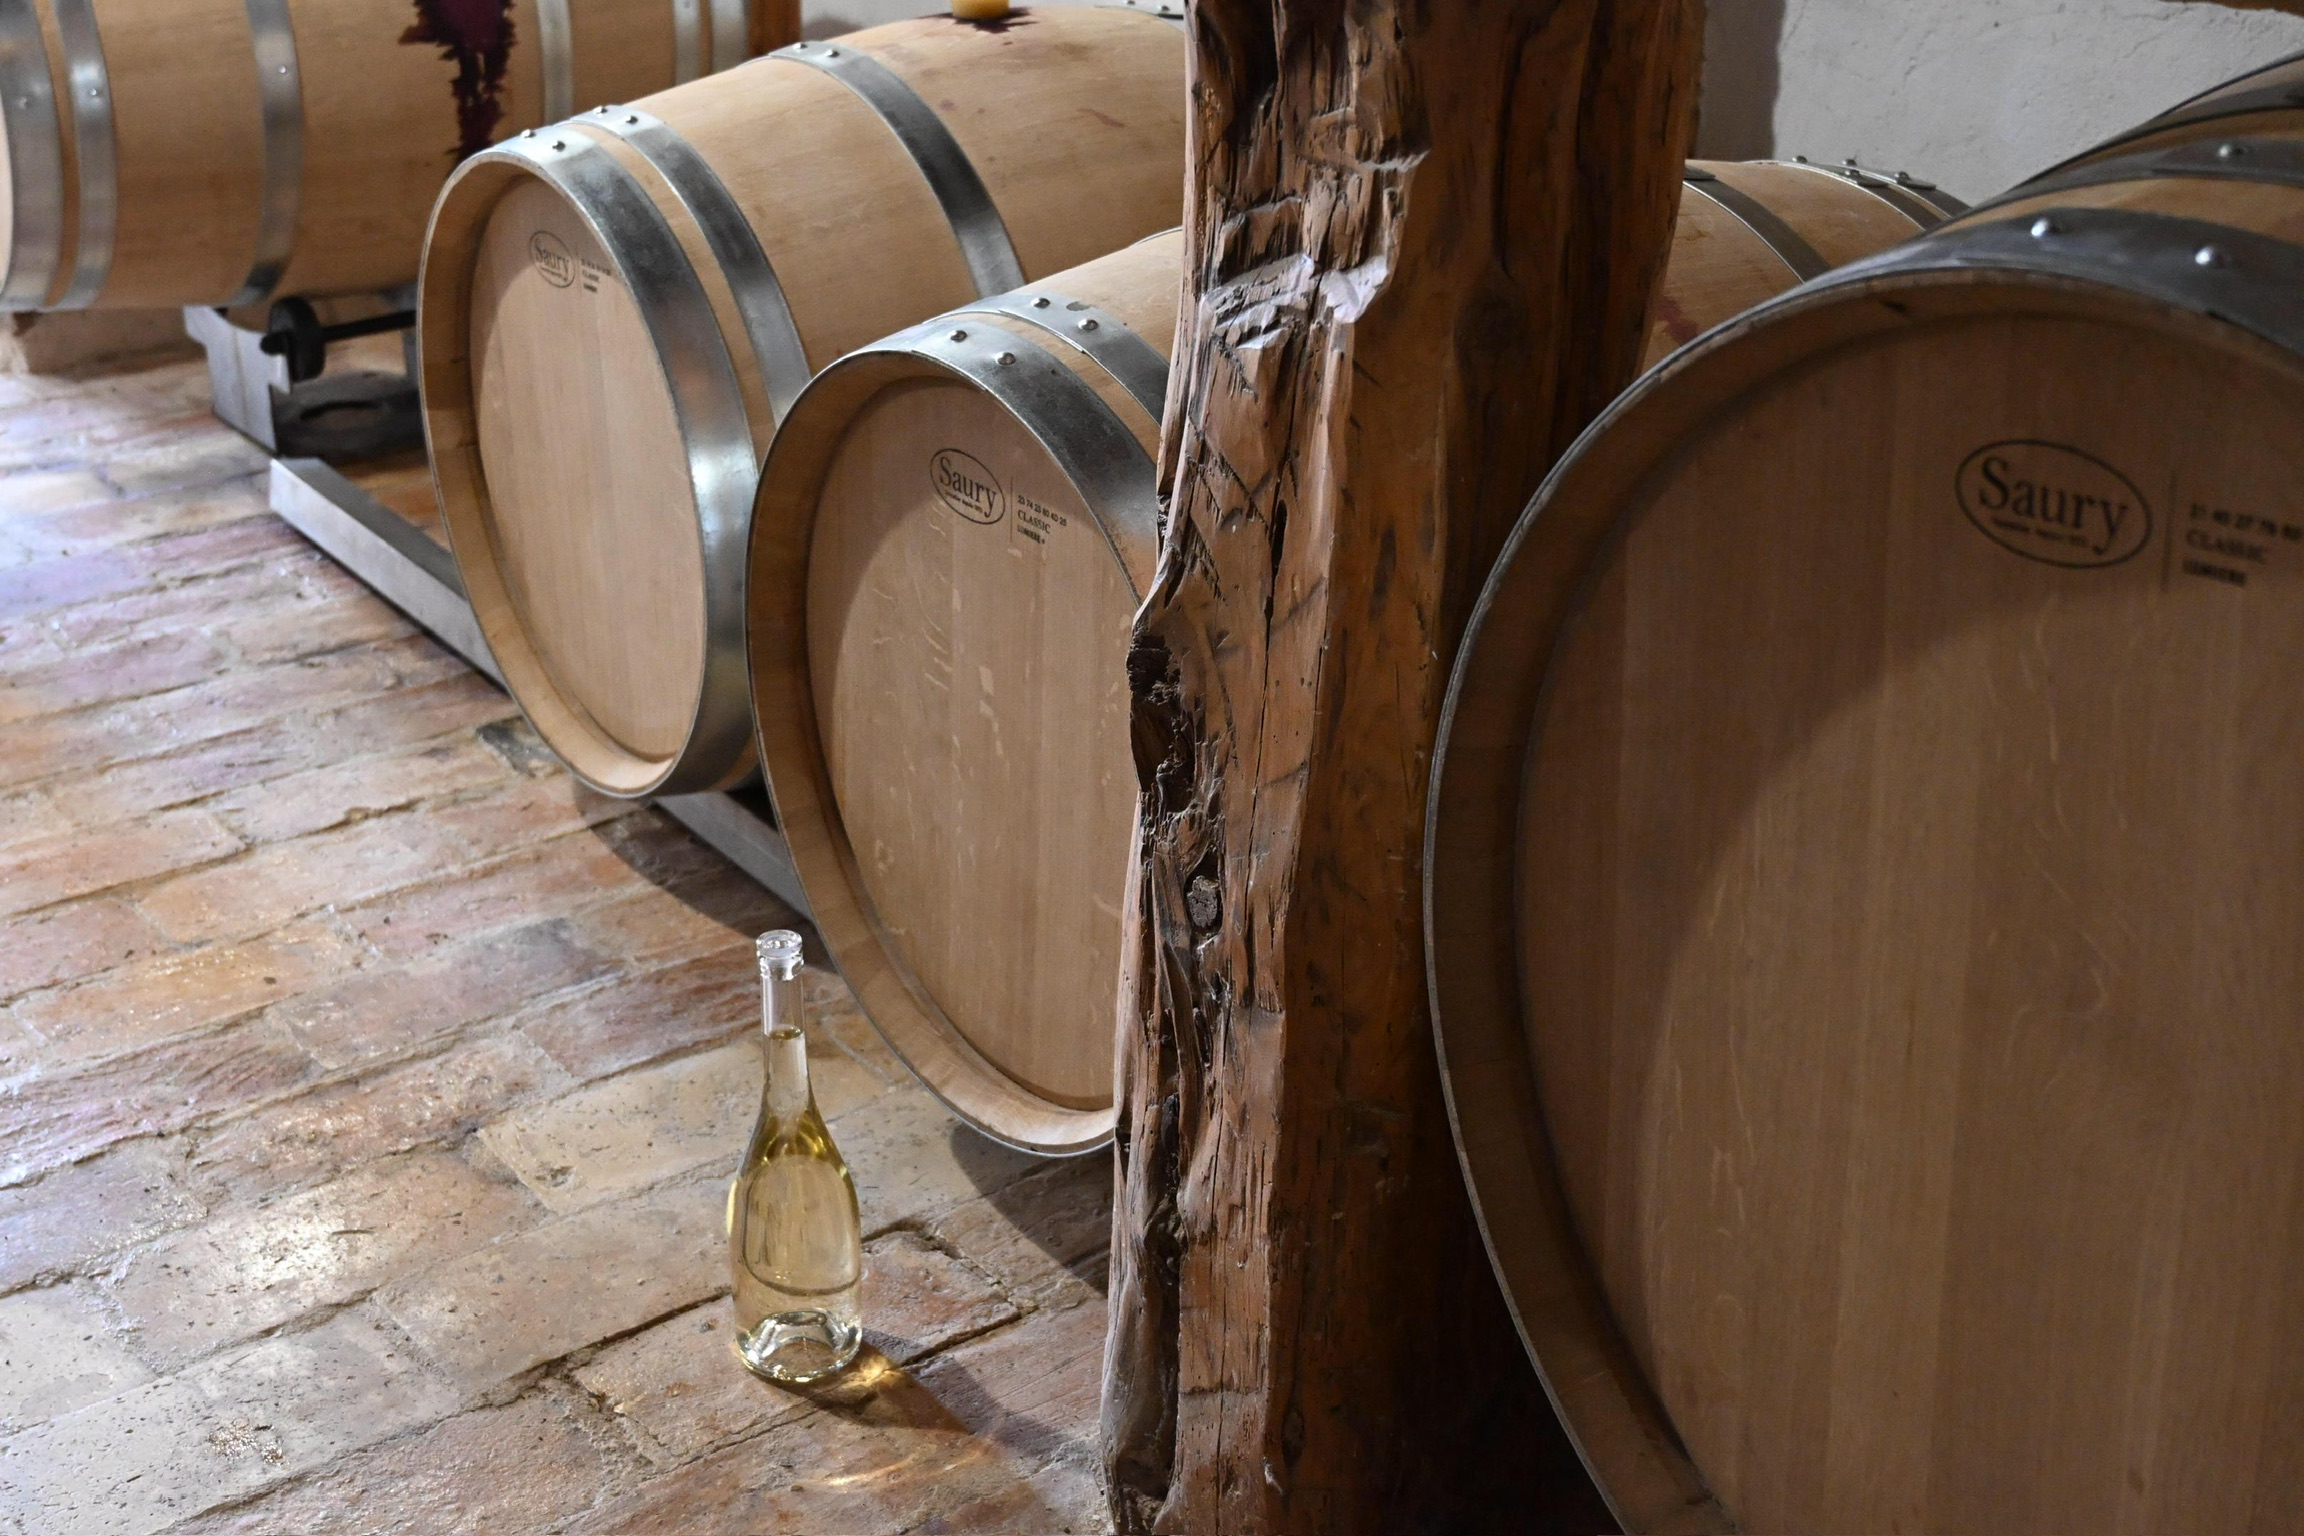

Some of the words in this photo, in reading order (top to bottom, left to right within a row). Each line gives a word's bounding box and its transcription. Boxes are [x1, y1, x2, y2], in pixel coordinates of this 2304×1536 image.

[535, 237, 570, 282] Saury
[940, 456, 997, 518] Saury
[1979, 456, 2129, 556] Saury
[1017, 509, 1051, 534] CLASSIC
